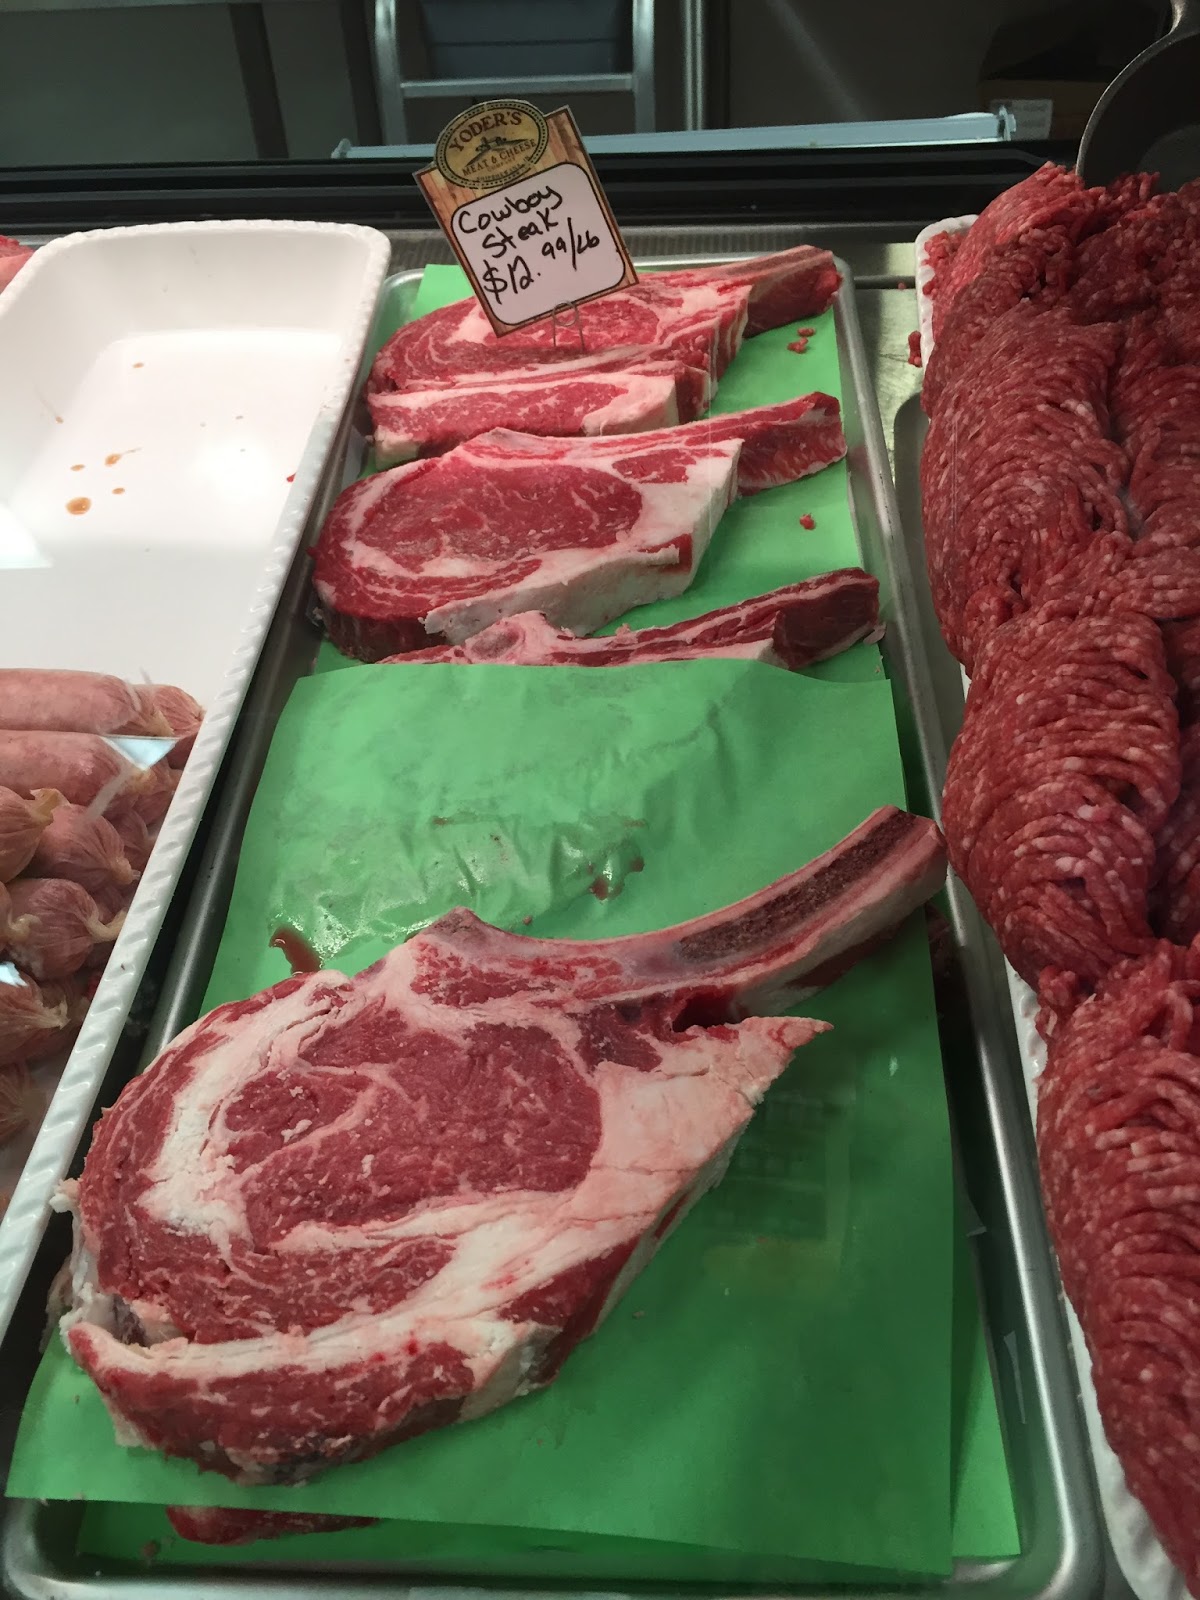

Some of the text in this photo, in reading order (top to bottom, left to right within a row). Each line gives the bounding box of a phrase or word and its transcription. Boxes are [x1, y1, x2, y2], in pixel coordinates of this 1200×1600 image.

[449, 110, 523, 152] YODER'S
[462, 138, 537, 177] MEAT & CHEESE
[458, 185, 563, 234] Cowboy
